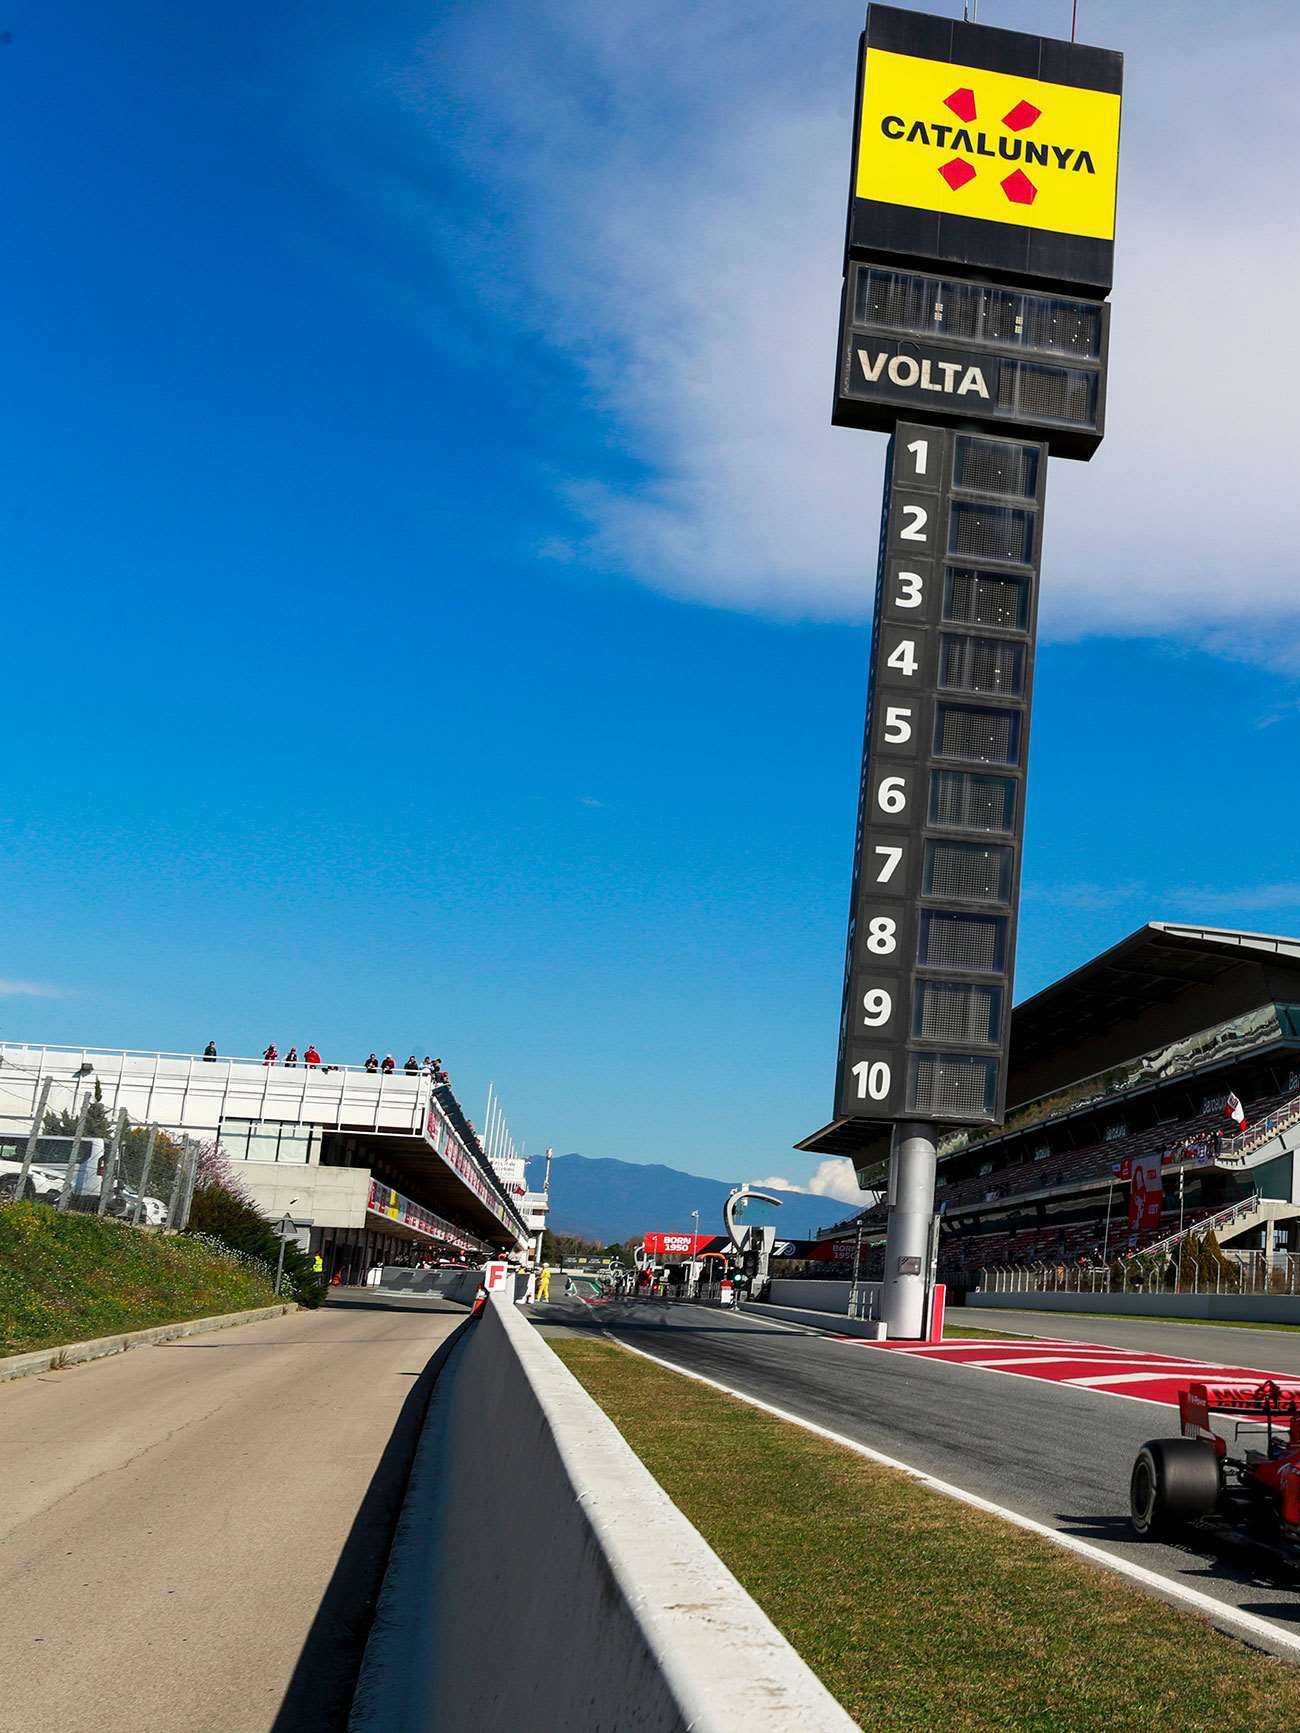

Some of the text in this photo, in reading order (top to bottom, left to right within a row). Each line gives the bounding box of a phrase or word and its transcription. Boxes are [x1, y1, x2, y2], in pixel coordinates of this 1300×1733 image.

[881, 115, 1096, 174] CATALUNYA
[857, 349, 990, 399] VOLTA
[906, 439, 929, 475] 1
[900, 505, 928, 542] 2
[894, 571, 924, 608] 3
[887, 639, 919, 676] 4
[884, 706, 912, 744] 5
[877, 776, 906, 814] 6
[875, 845, 903, 883] 7
[866, 916, 897, 955] 8
[863, 988, 892, 1027] 9
[851, 1060, 891, 1101] 10
[664, 1236, 691, 1244] BORN
[488, 1265, 505, 1289] F
